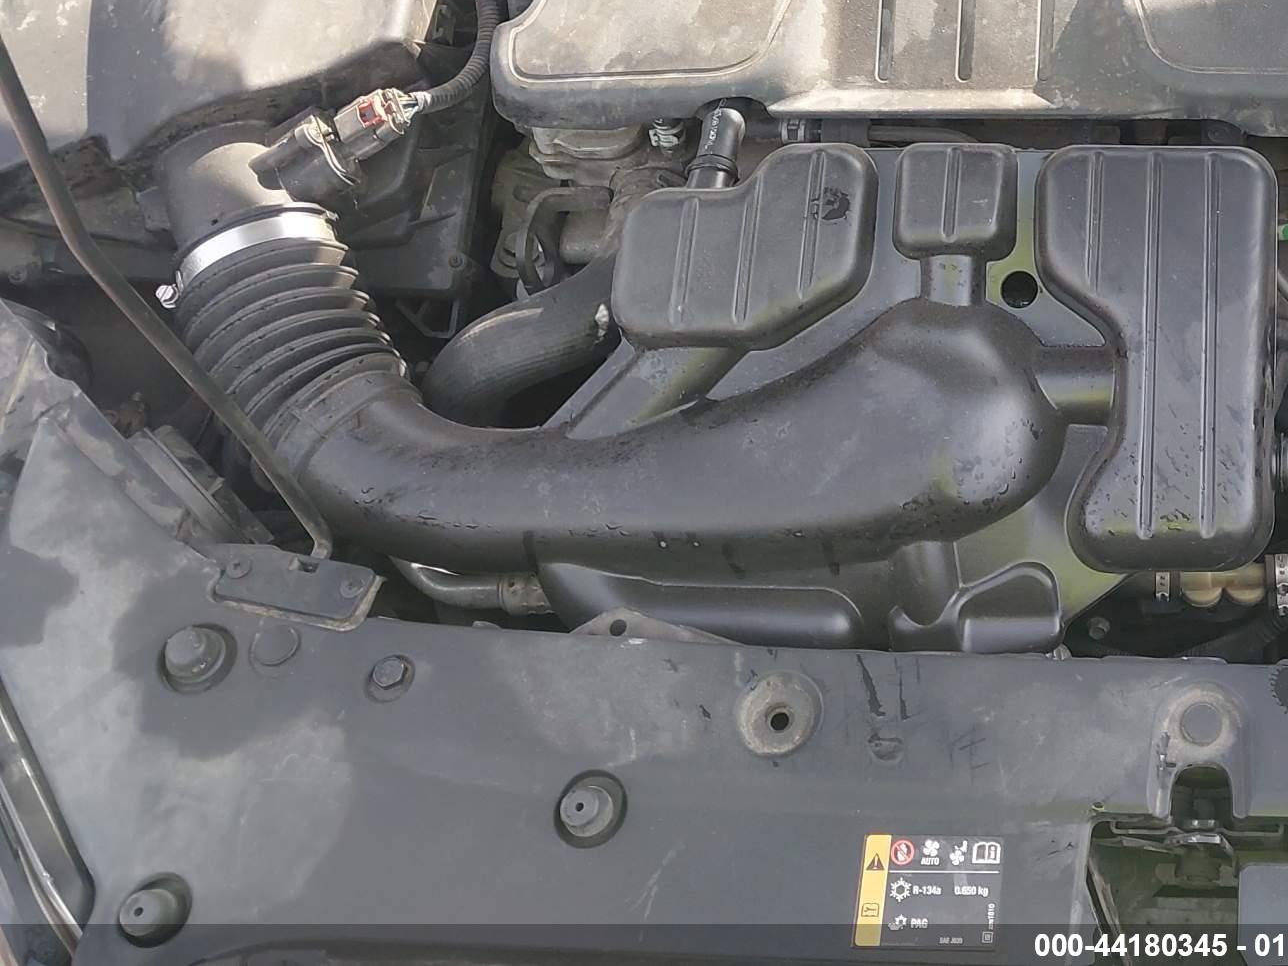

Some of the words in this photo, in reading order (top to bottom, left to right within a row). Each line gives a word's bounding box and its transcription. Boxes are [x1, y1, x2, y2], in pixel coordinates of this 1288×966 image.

[921, 857, 940, 865] AUTO
[912, 885, 942, 895] R-134a
[977, 886, 989, 897] kg
[910, 918, 928, 929] PAG
